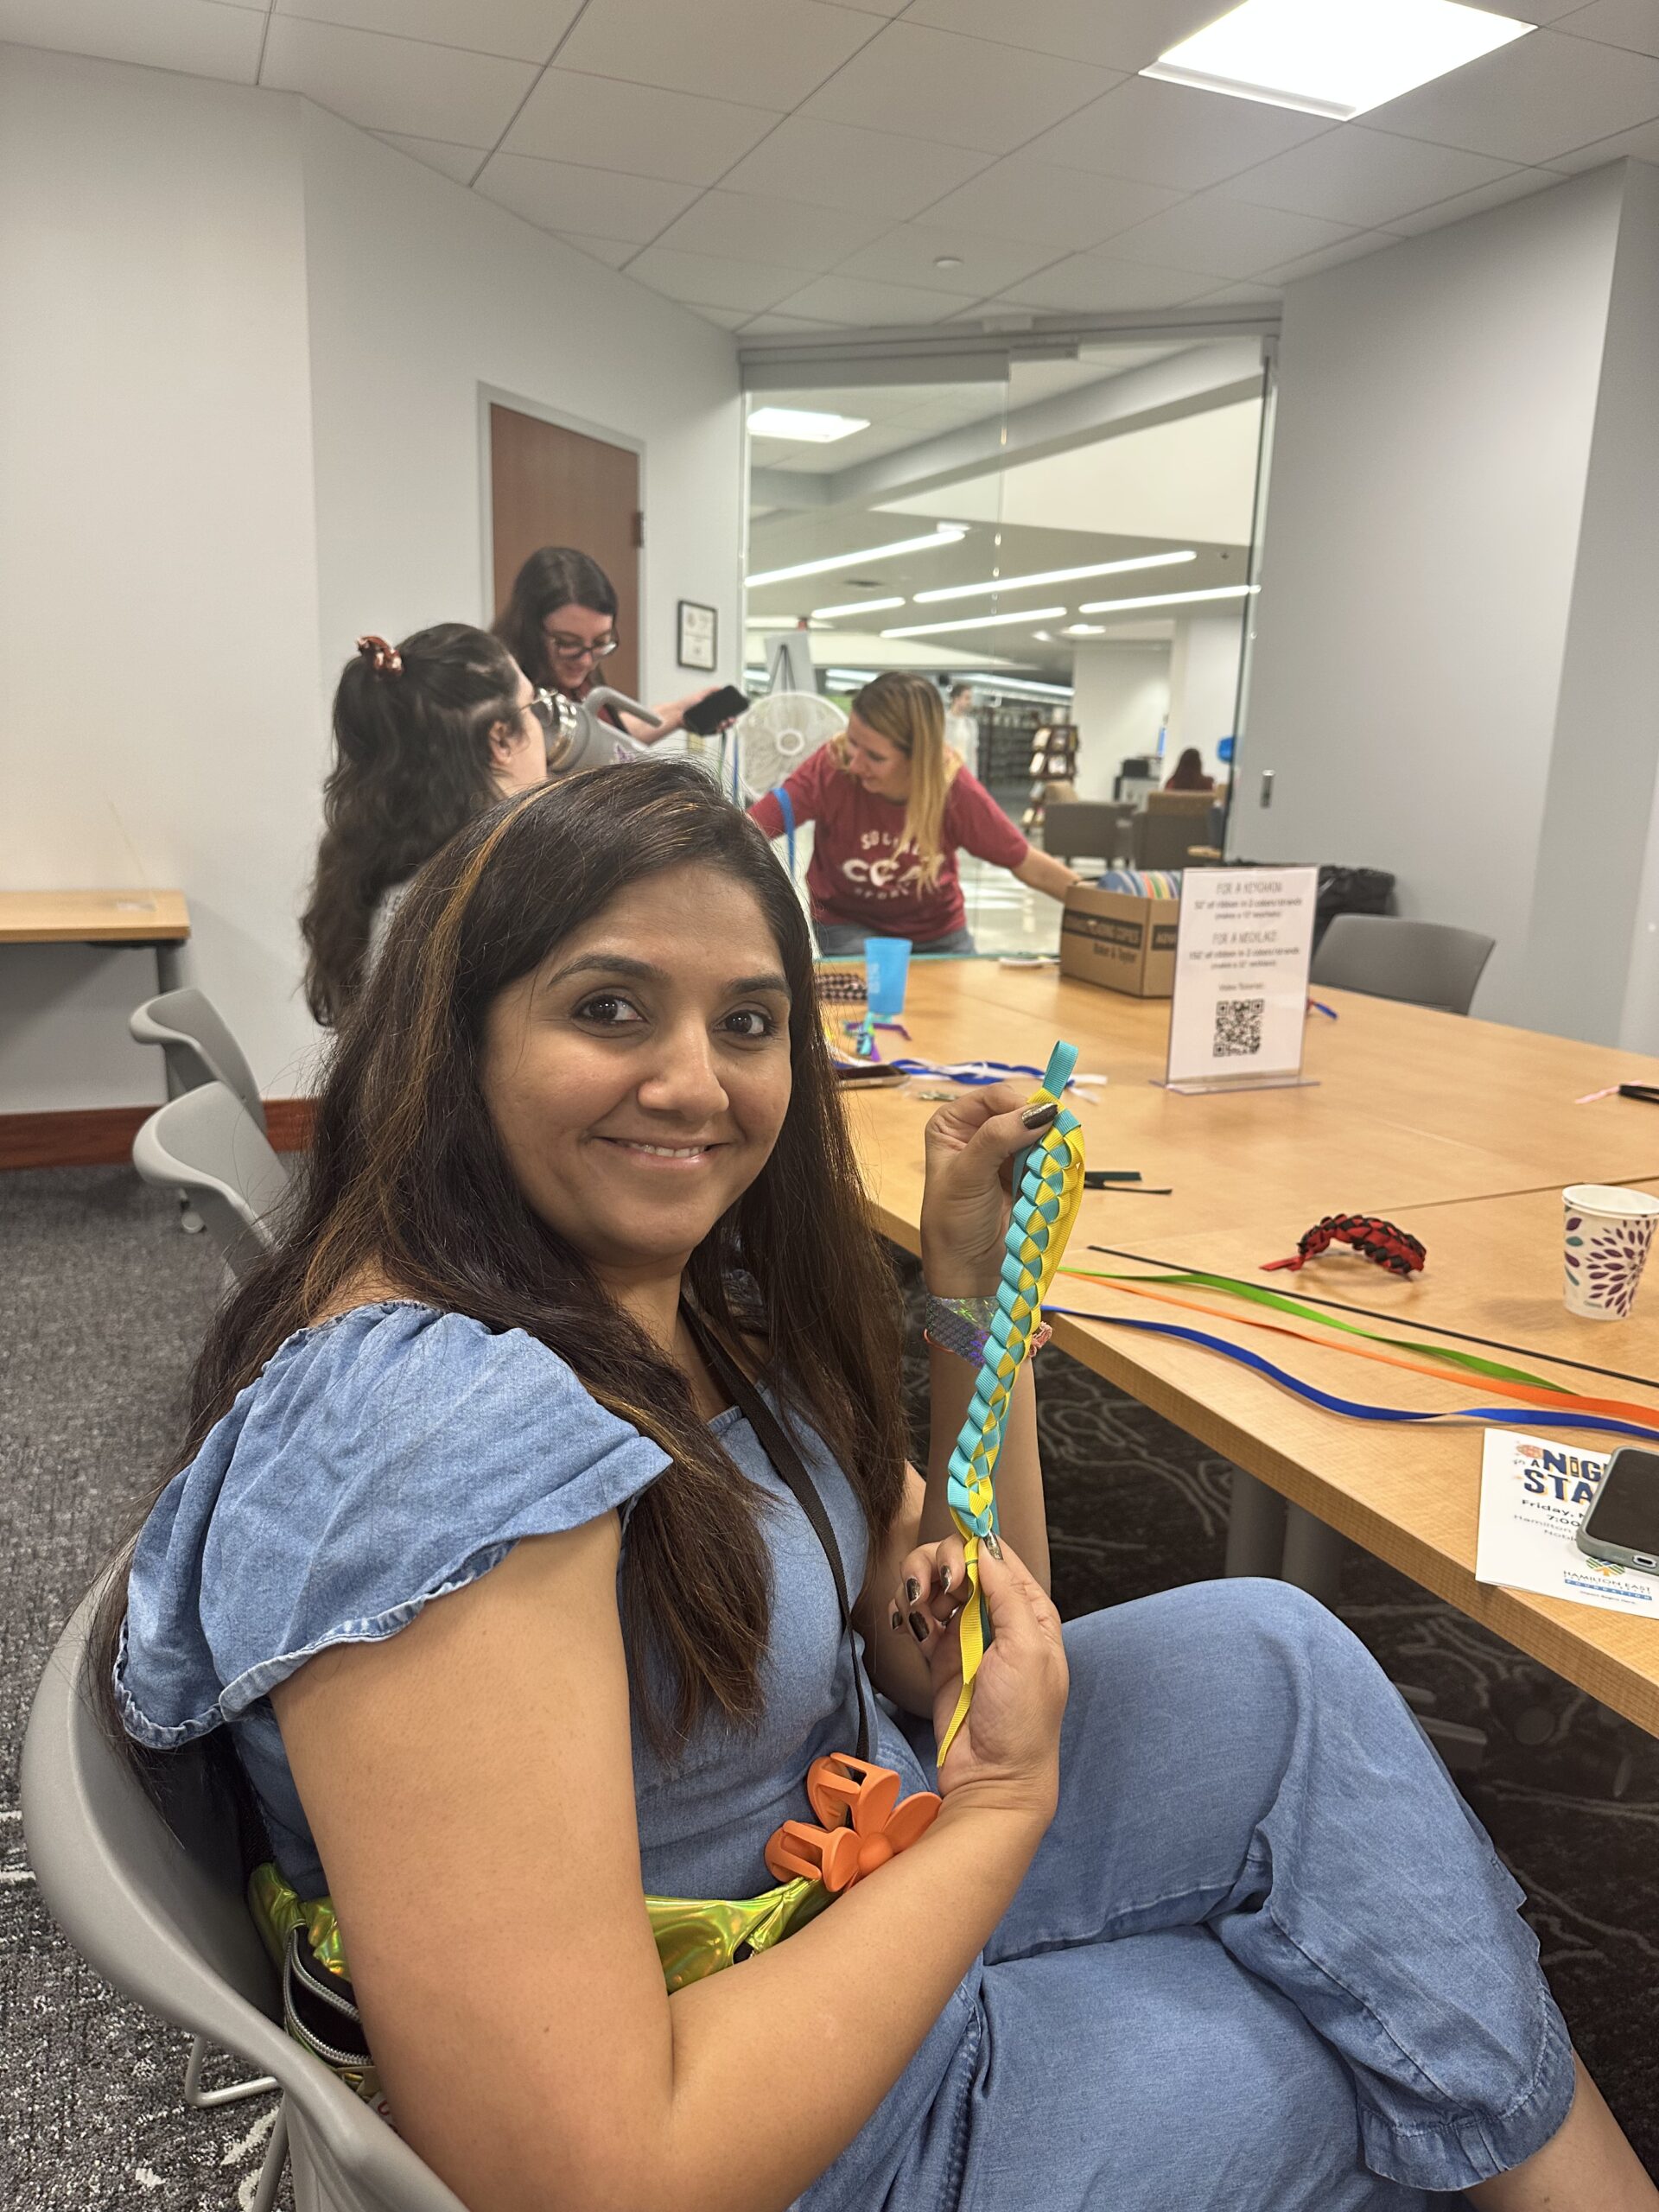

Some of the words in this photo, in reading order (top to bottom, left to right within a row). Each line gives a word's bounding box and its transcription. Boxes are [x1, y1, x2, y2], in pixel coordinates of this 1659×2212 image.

[1217, 882, 1232, 895] FOR
[1235, 881, 1242, 893] A
[1212, 932, 1228, 945] FOR
[1230, 931, 1237, 944] A
[1530, 1459, 1541, 1468] A
[1542, 1448, 1608, 1483] NIG
[1514, 1514, 1572, 1534] Hamilton
[1547, 1513, 1581, 1527] 7:00
[1563, 1569, 1621, 1586] HAMILTON
[1624, 1582, 1651, 1592] EAST
